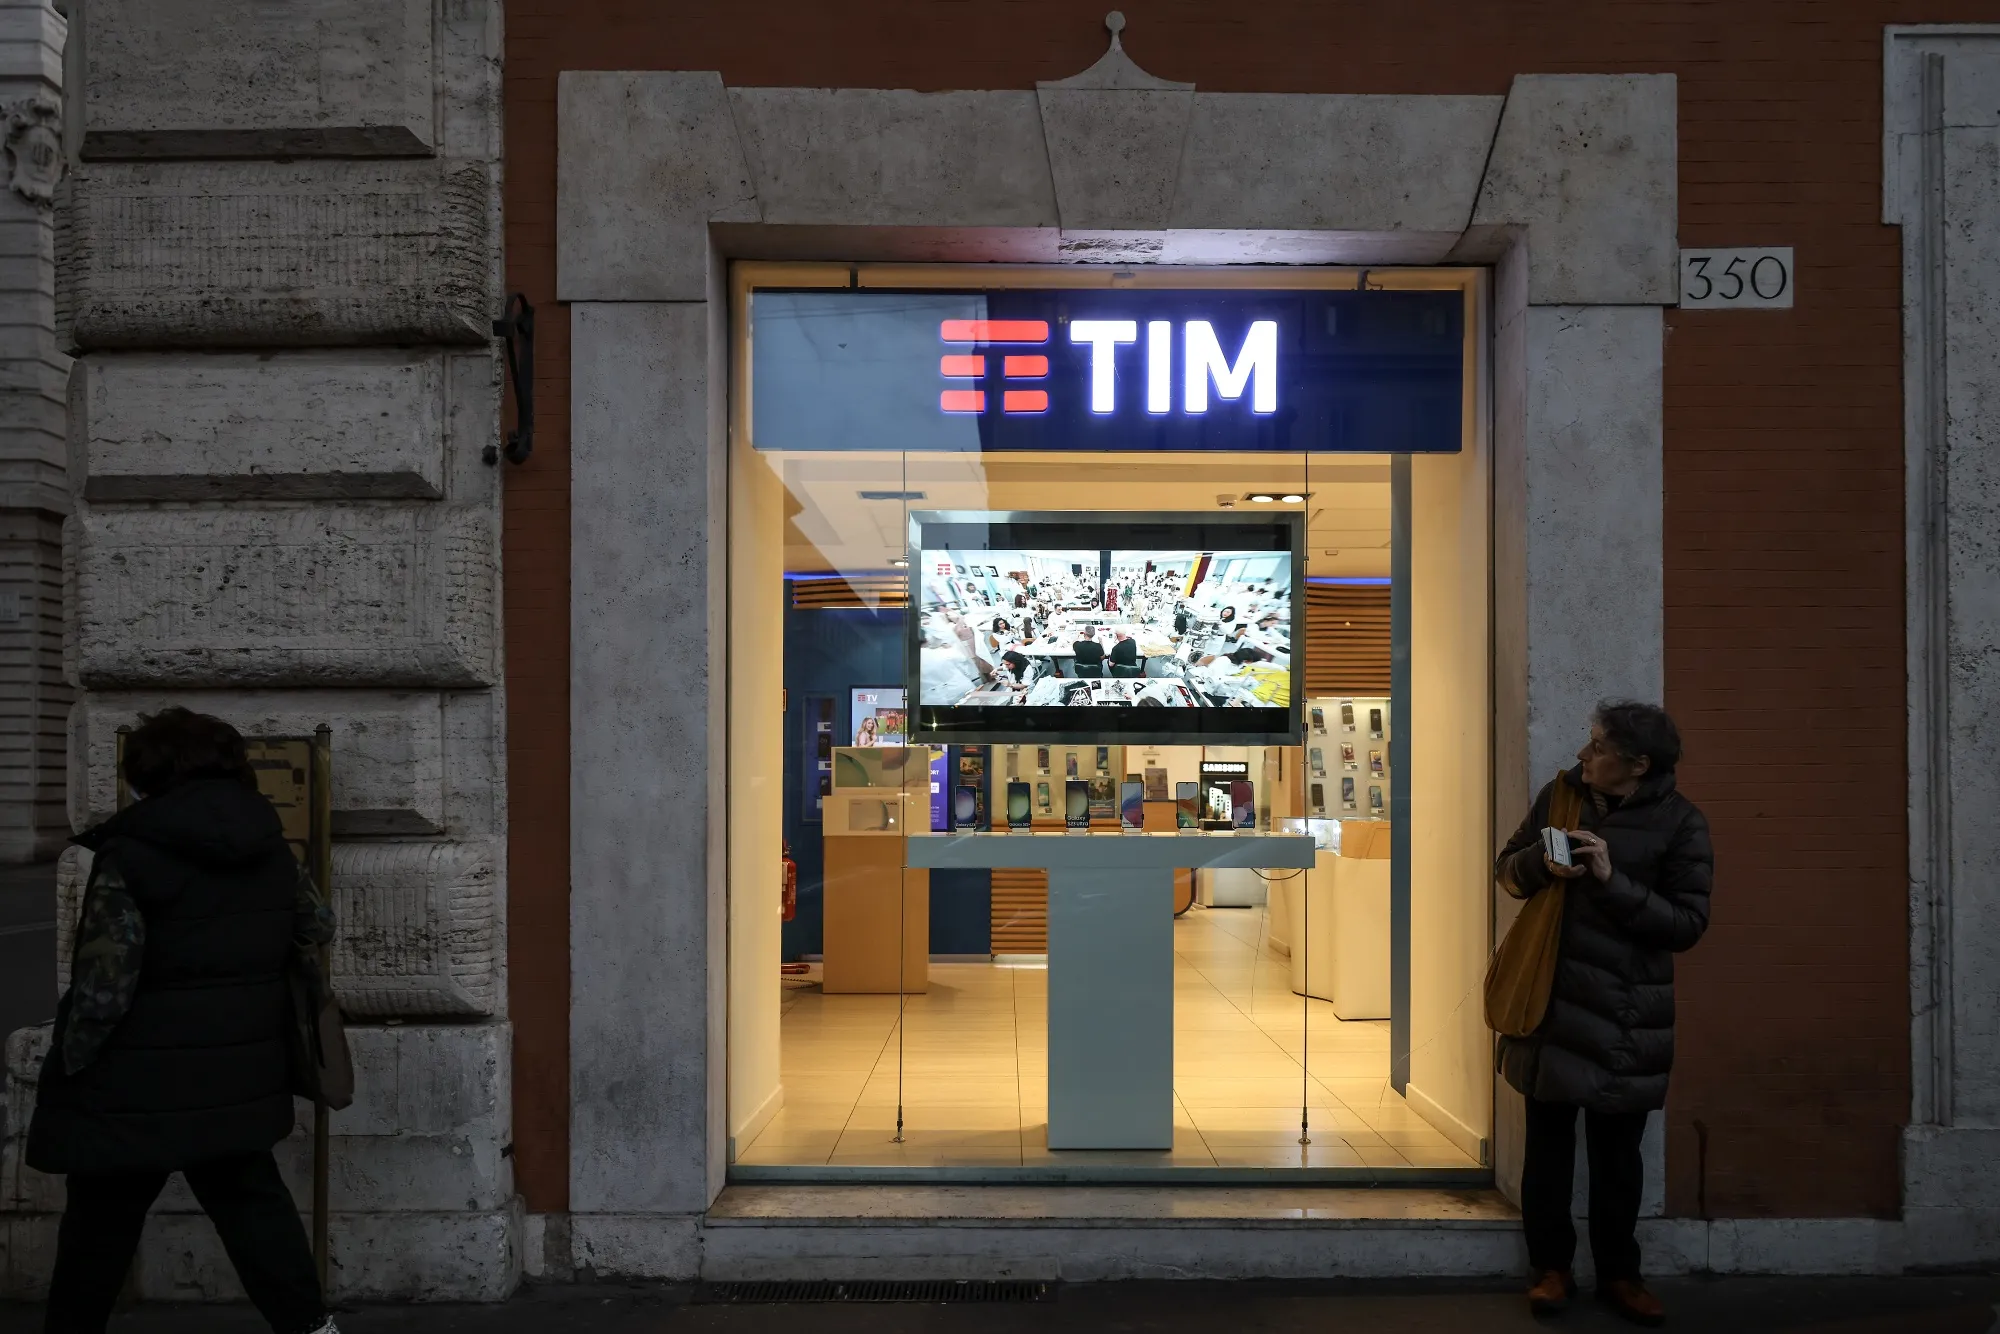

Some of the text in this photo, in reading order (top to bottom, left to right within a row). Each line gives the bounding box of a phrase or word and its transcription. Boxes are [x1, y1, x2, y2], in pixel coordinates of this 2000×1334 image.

[1687, 255, 1788, 300] 350
[1070, 320, 1278, 414] TIM
[867, 694, 878, 702] TV
[1203, 763, 1246, 772] SAMSUNG
